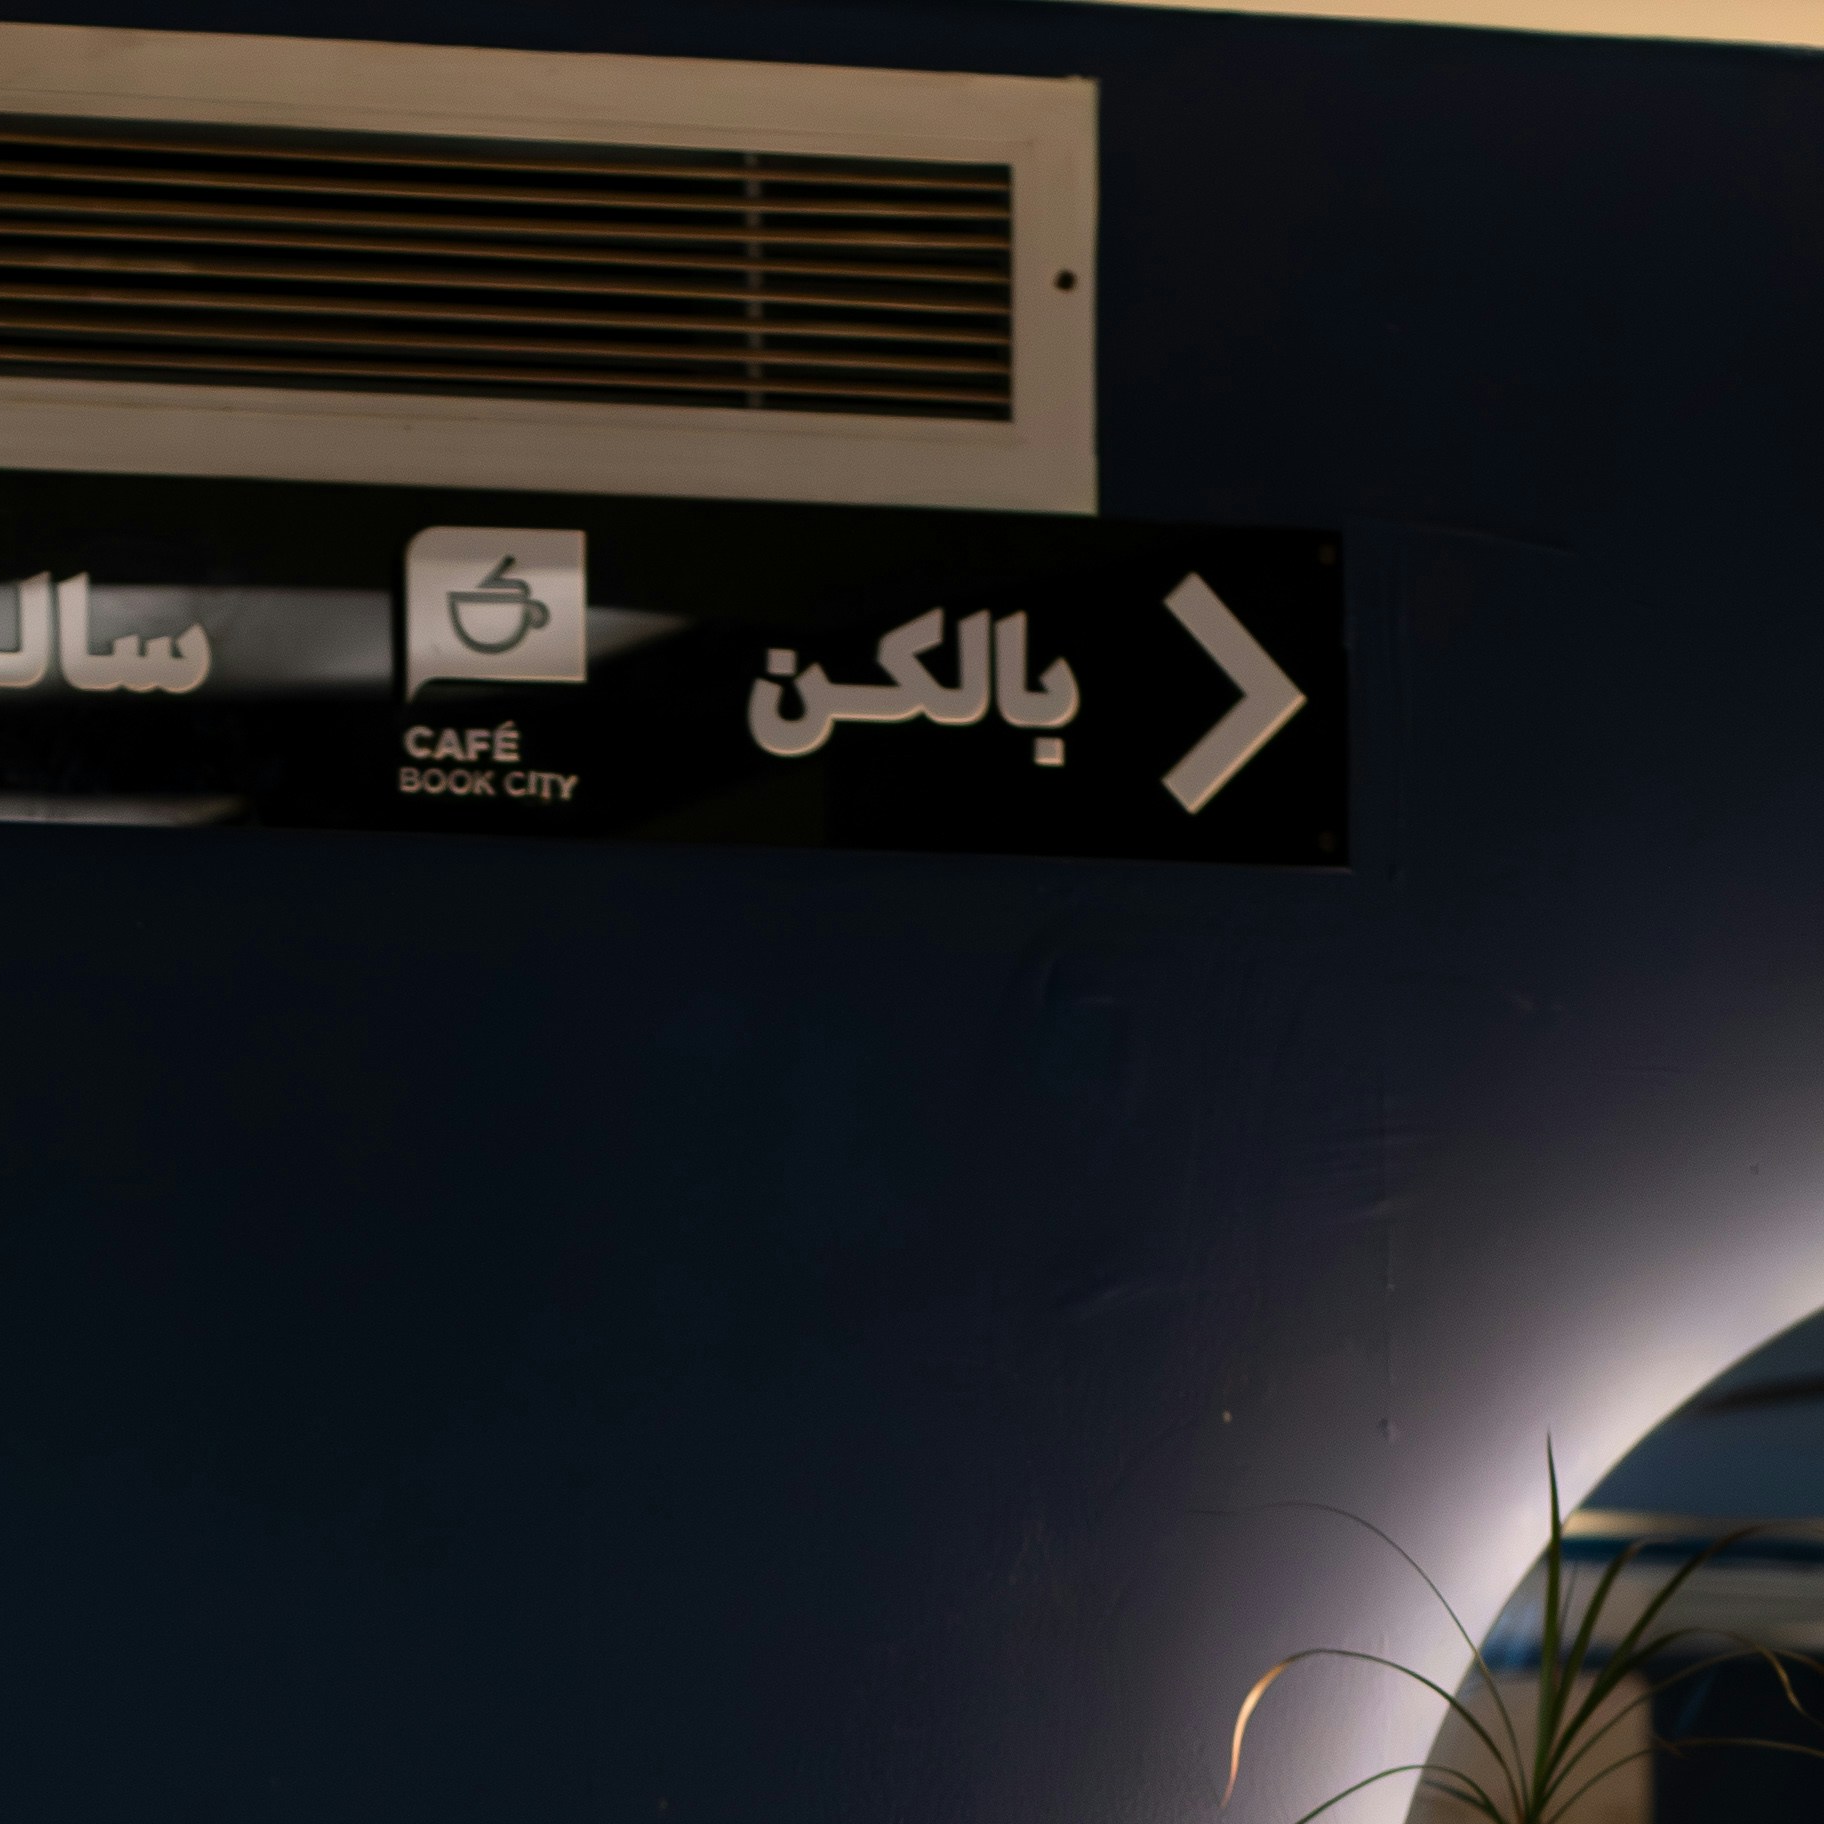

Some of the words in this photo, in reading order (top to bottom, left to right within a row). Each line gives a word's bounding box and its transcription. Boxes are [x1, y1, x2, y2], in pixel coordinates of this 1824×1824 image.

[747, 605, 1080, 767] بالکن
[404, 719, 521, 762] CAFÉ
[399, 766, 495, 796] BOOK
[504, 771, 578, 801] CITY
